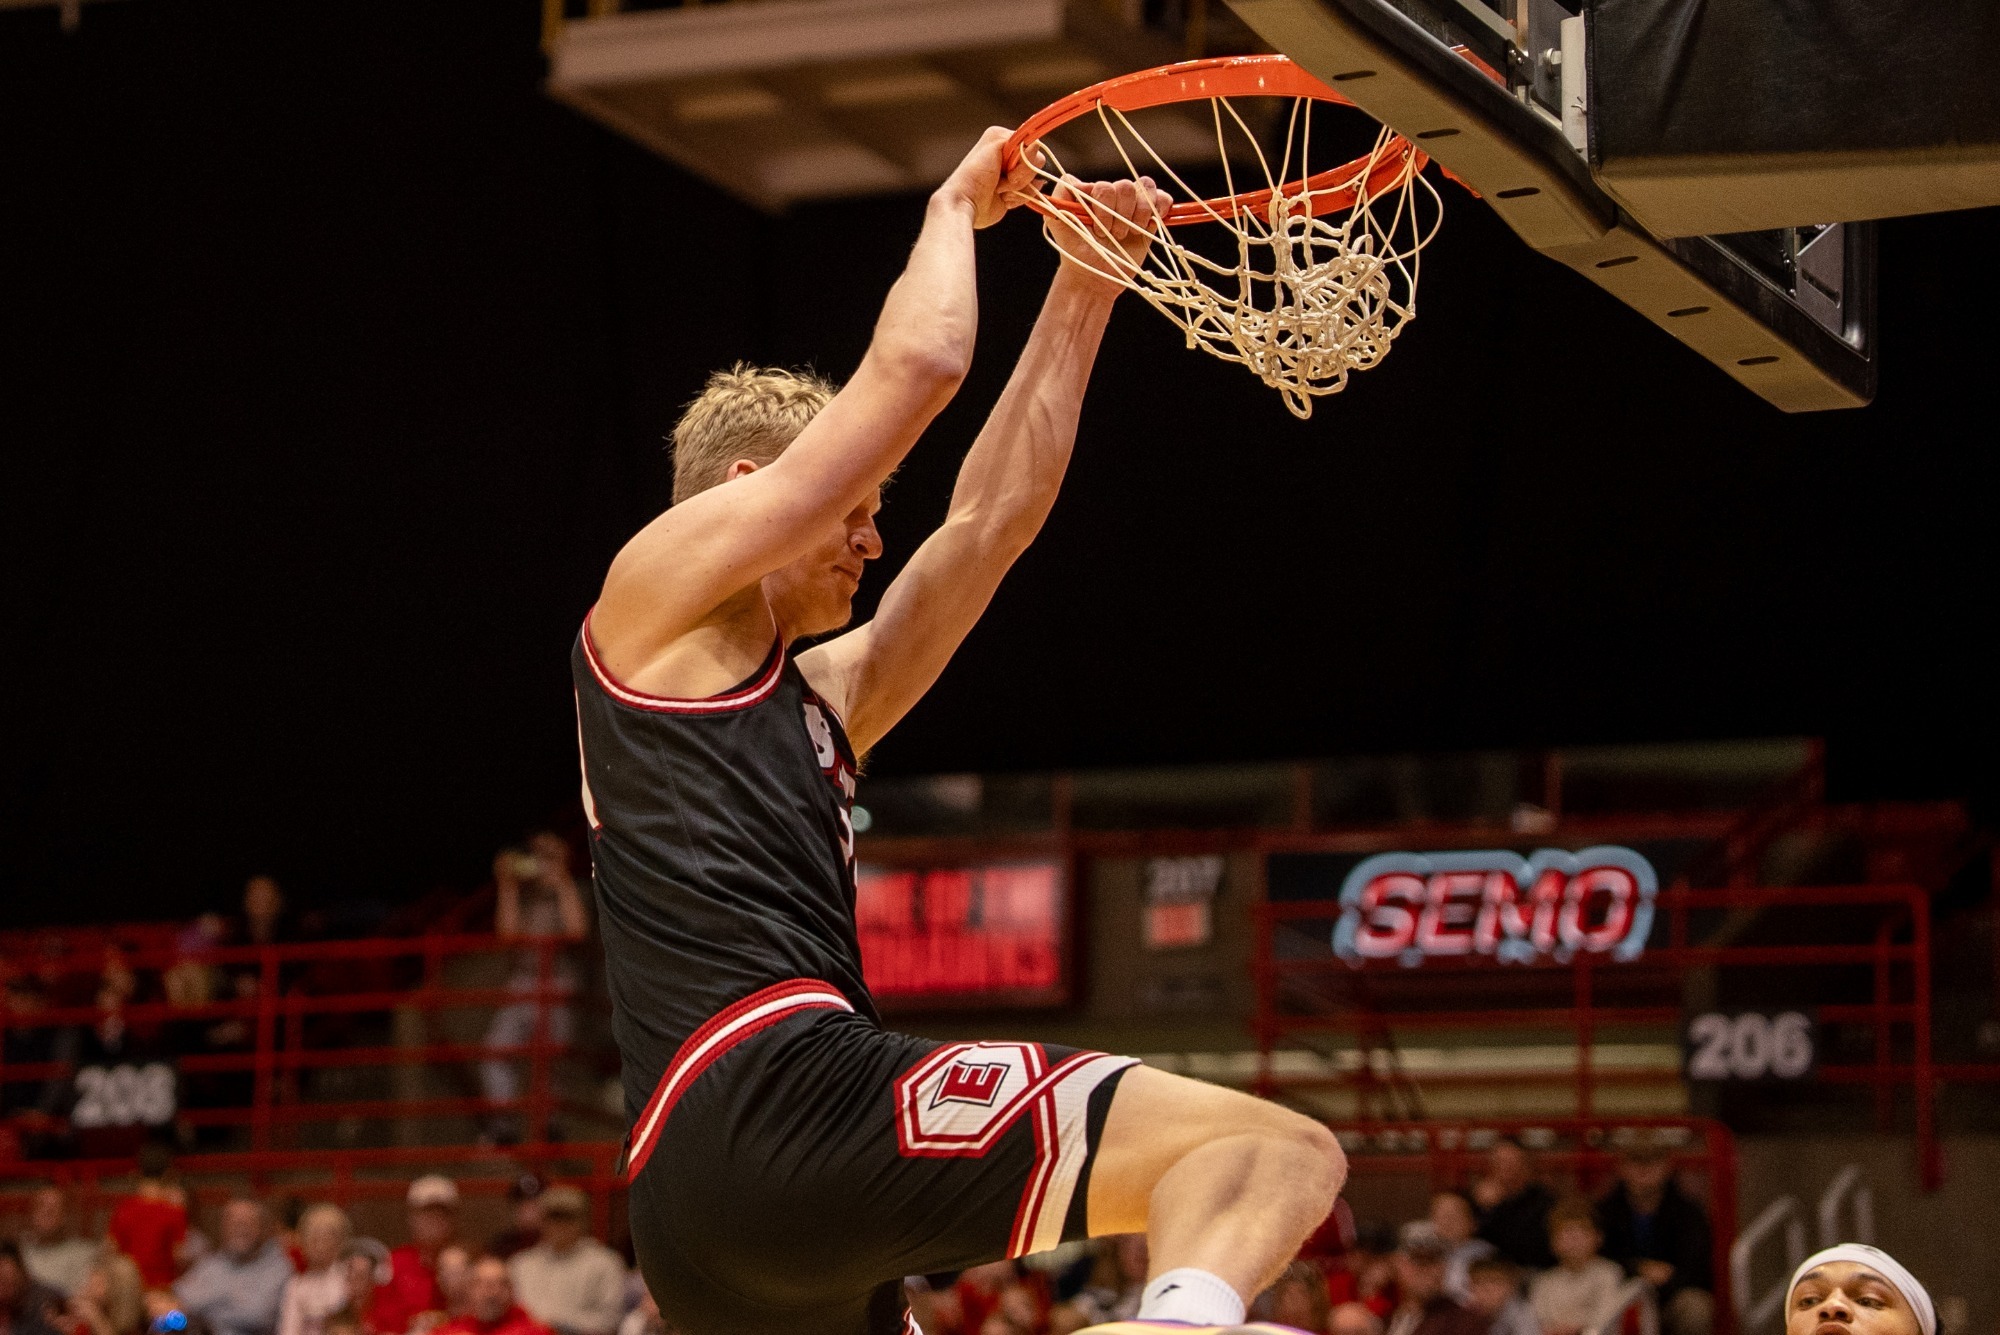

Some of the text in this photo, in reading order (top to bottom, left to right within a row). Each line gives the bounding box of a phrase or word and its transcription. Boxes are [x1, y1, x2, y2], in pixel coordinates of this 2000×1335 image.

[1354, 865, 1639, 958] SEMO
[1689, 1011, 1813, 1079] 206
[929, 1060, 1010, 1110] E
